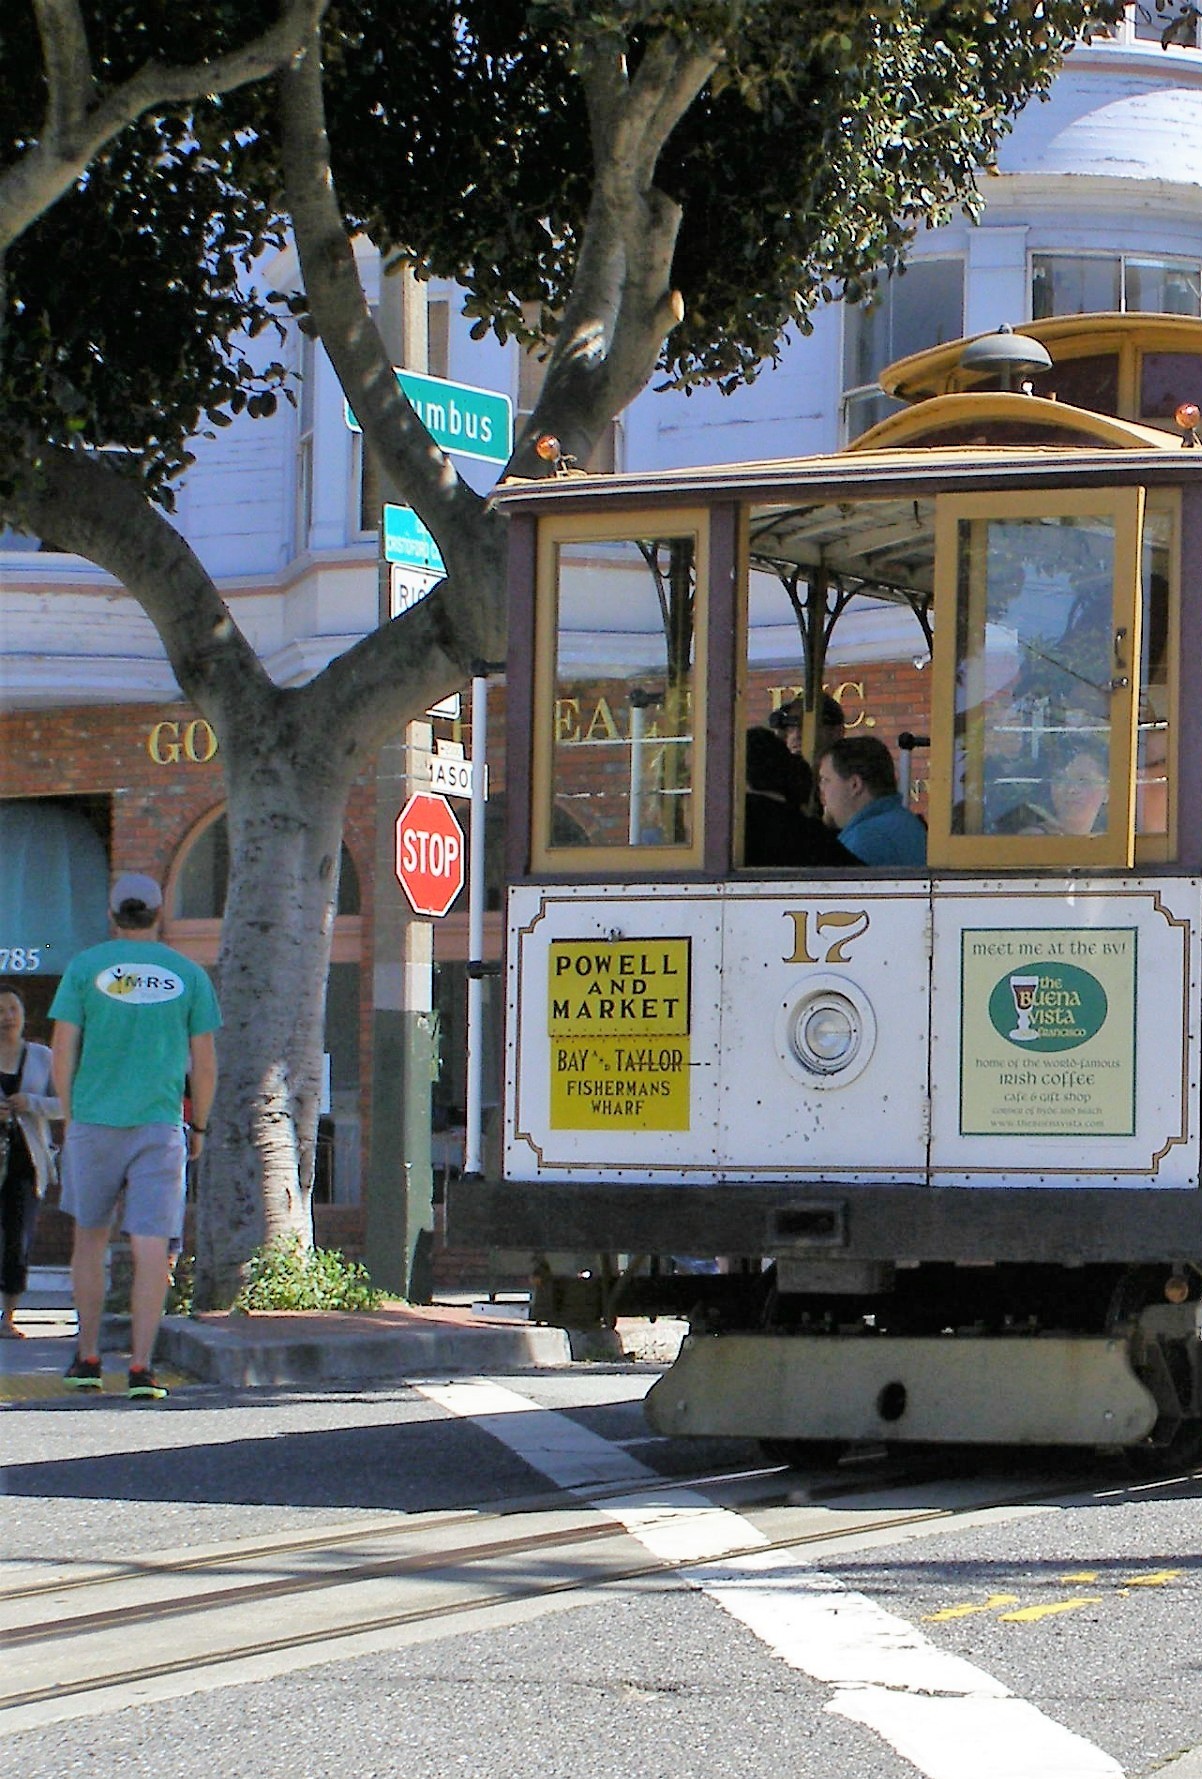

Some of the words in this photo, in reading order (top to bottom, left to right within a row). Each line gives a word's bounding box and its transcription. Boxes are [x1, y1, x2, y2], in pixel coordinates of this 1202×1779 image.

[403, 828, 459, 878] STOP
[782, 910, 869, 963] 17
[0, 948, 40, 971] 785
[556, 954, 679, 976] POWELL
[588, 979, 648, 995] AND
[553, 998, 679, 1019] MARKET
[558, 1049, 588, 1072] BAY
[615, 1049, 683, 1072] TAYLOR
[567, 1080, 671, 1096] FISHERMANS
[591, 1100, 646, 1115] WHARF
